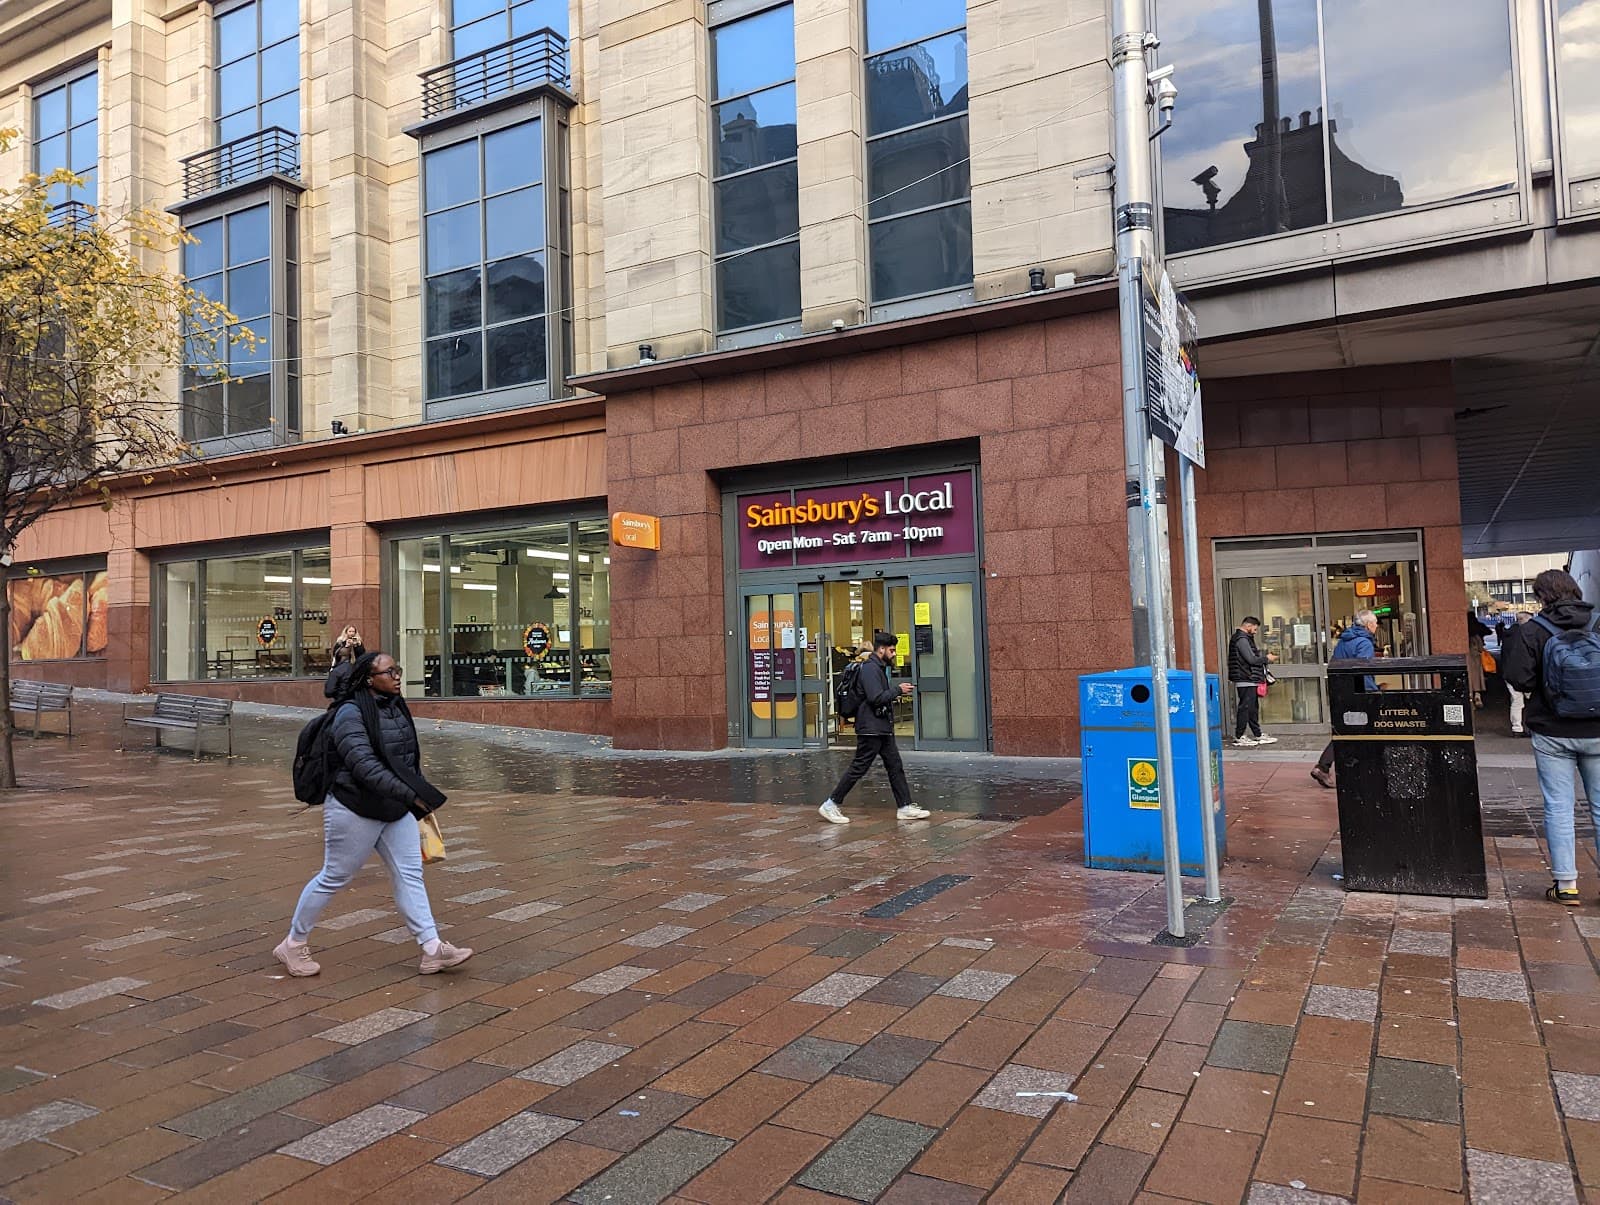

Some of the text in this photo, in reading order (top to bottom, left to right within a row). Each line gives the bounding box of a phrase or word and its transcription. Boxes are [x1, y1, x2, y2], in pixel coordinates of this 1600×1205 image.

[746, 482, 954, 529] Sainsbury's Local
[622, 519, 651, 529] Sainsbury's
[757, 539, 792, 555] Open
[793, 536, 823, 550] Mon
[832, 532, 857, 546] Sat
[861, 530, 892, 544] 7am
[903, 526, 944, 542] 10pm
[275, 607, 328, 624] Baery
[753, 634, 770, 643] Loca
[1394, 720, 1426, 728] WASTE
[1131, 793, 1159, 802] Glasgow
